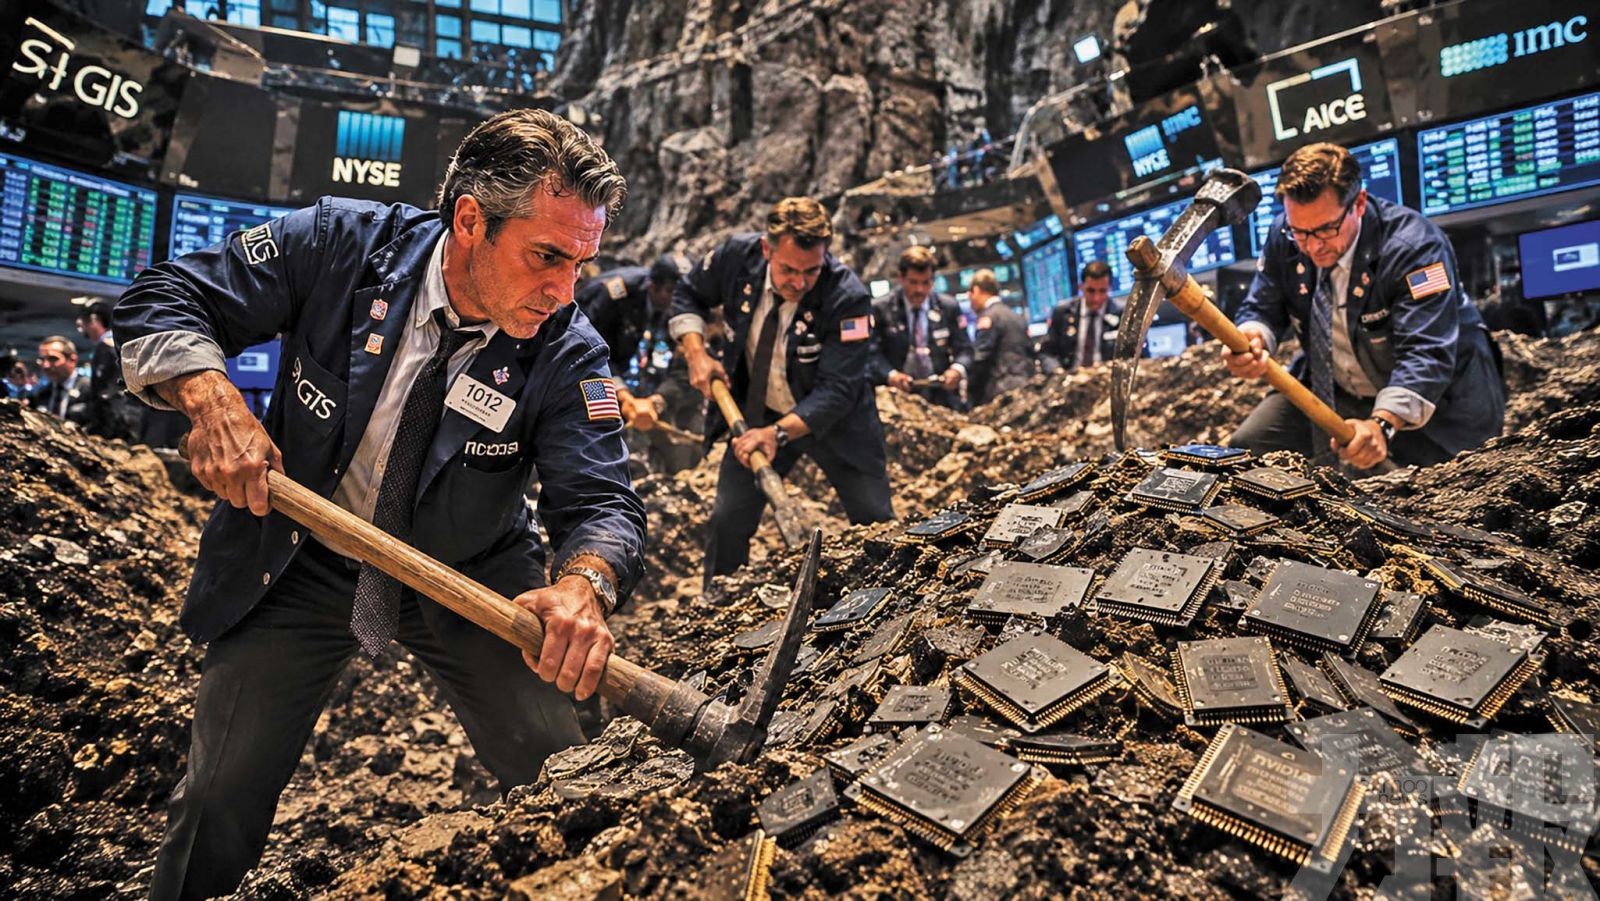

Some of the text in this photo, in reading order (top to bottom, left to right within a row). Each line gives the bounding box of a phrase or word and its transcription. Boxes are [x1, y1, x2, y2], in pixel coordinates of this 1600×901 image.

[1303, 93, 1367, 133] AICE
[332, 157, 402, 187] NYSE
[466, 383, 503, 412] 1012
